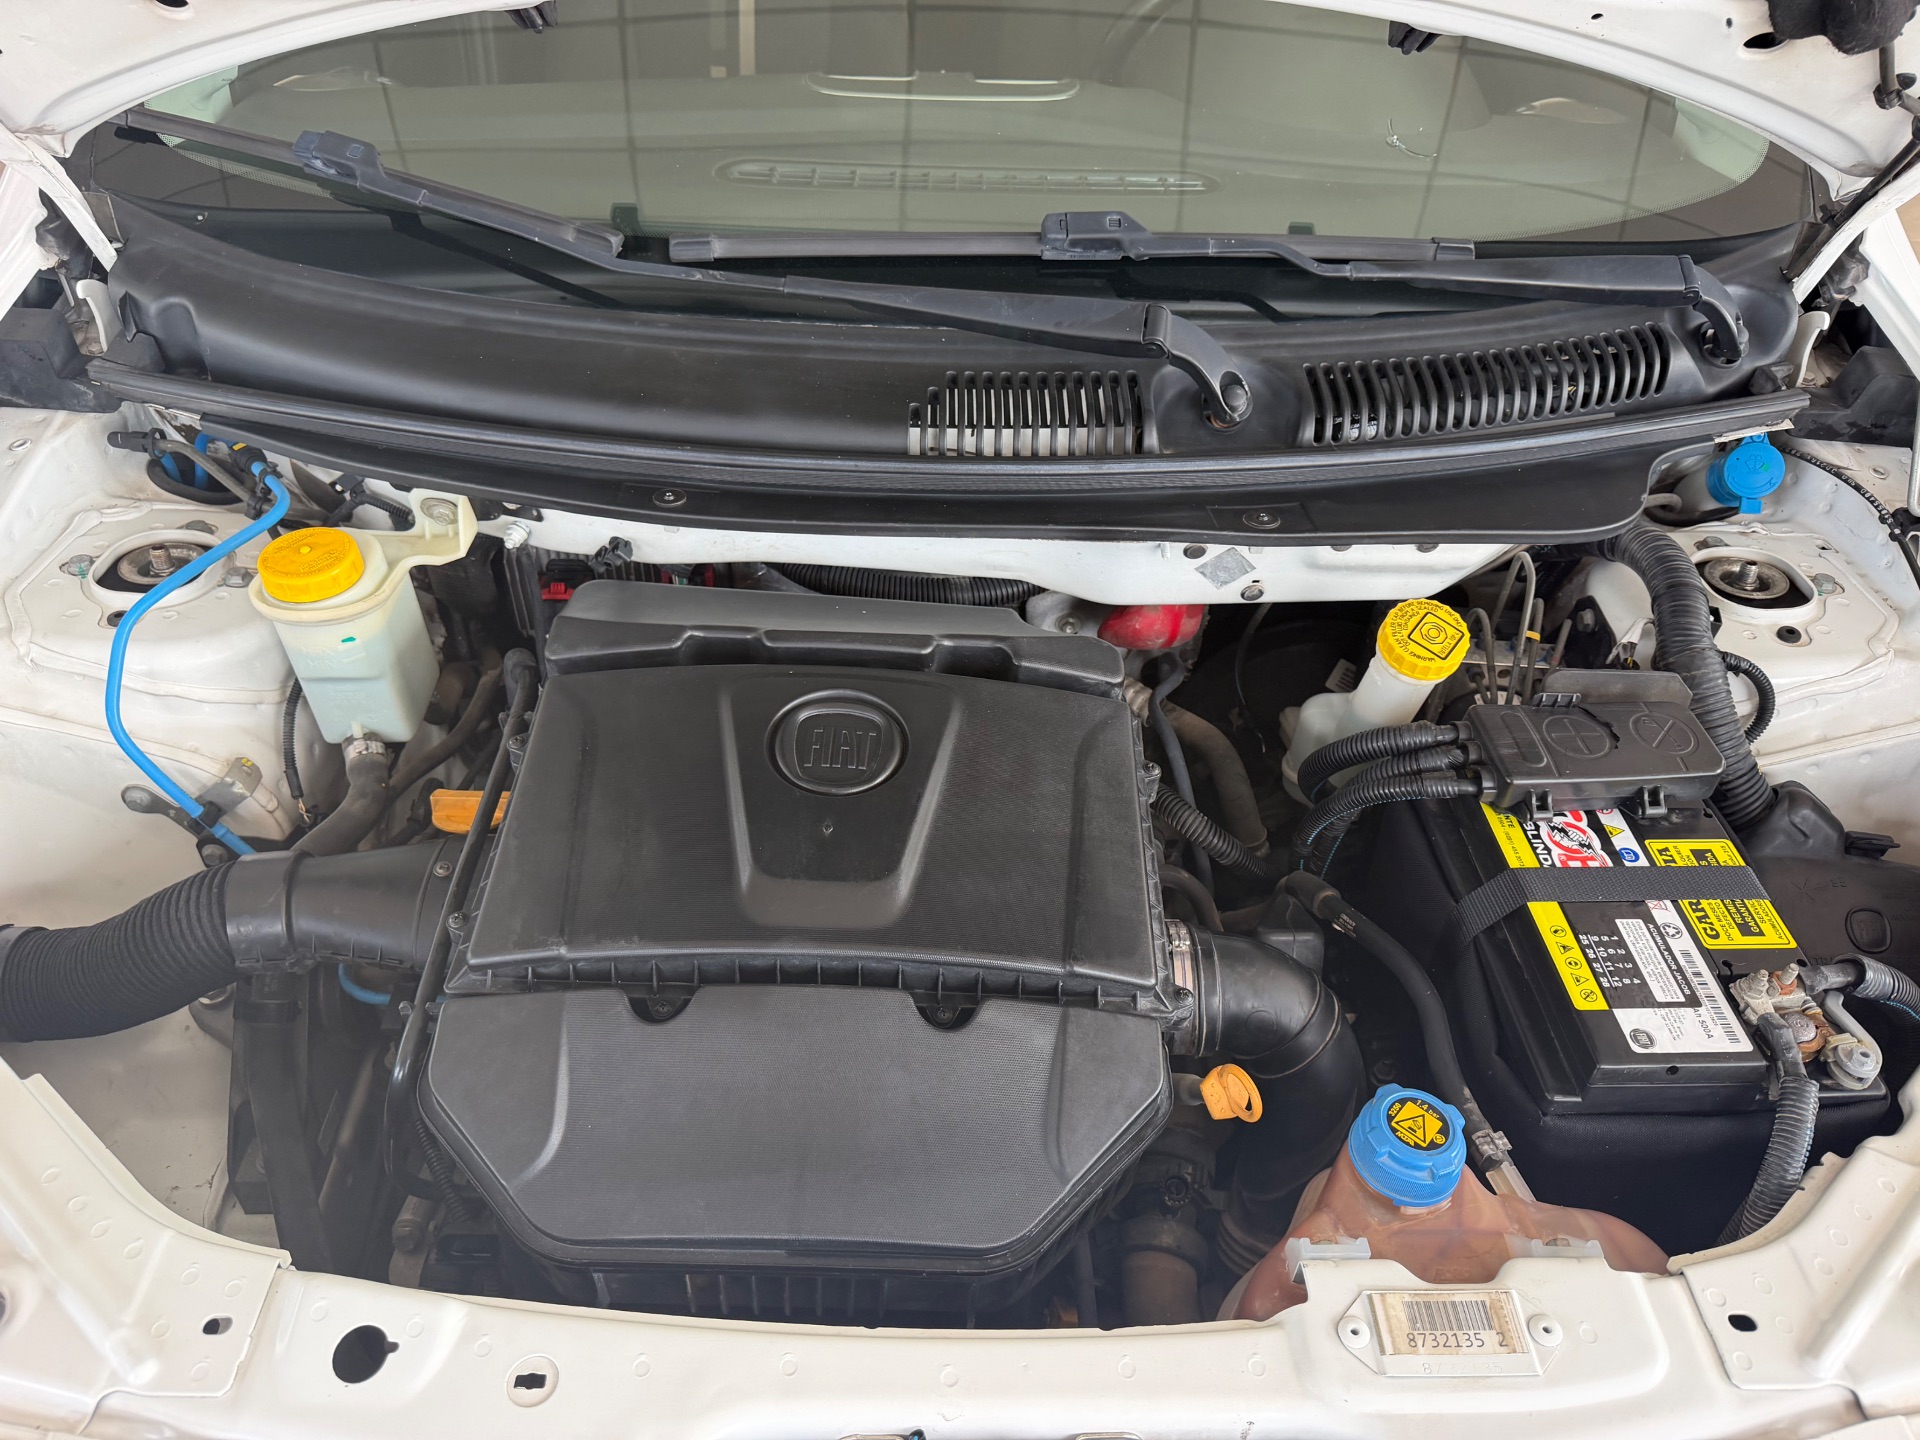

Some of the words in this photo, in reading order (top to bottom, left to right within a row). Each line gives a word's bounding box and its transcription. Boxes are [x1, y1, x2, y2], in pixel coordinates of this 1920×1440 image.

[804, 728, 876, 770] FIAT
[1577, 934, 1590, 944] 25
[1584, 948, 1597, 958] 26
[1591, 962, 1604, 972] 27
[1598, 976, 1611, 986] 28
[1595, 946, 1608, 956] 10
[1602, 961, 1615, 970] 11
[1610, 976, 1623, 986] 12
[1647, 923, 1678, 969] ACUMULADOR
[1672, 970, 1691, 994] JACOB
[1416, 1100, 1428, 1110] 1.4
[1428, 1110, 1440, 1118] bar
[1406, 1332, 1485, 1348] 8732135
[1498, 1332, 1508, 1347] 2
